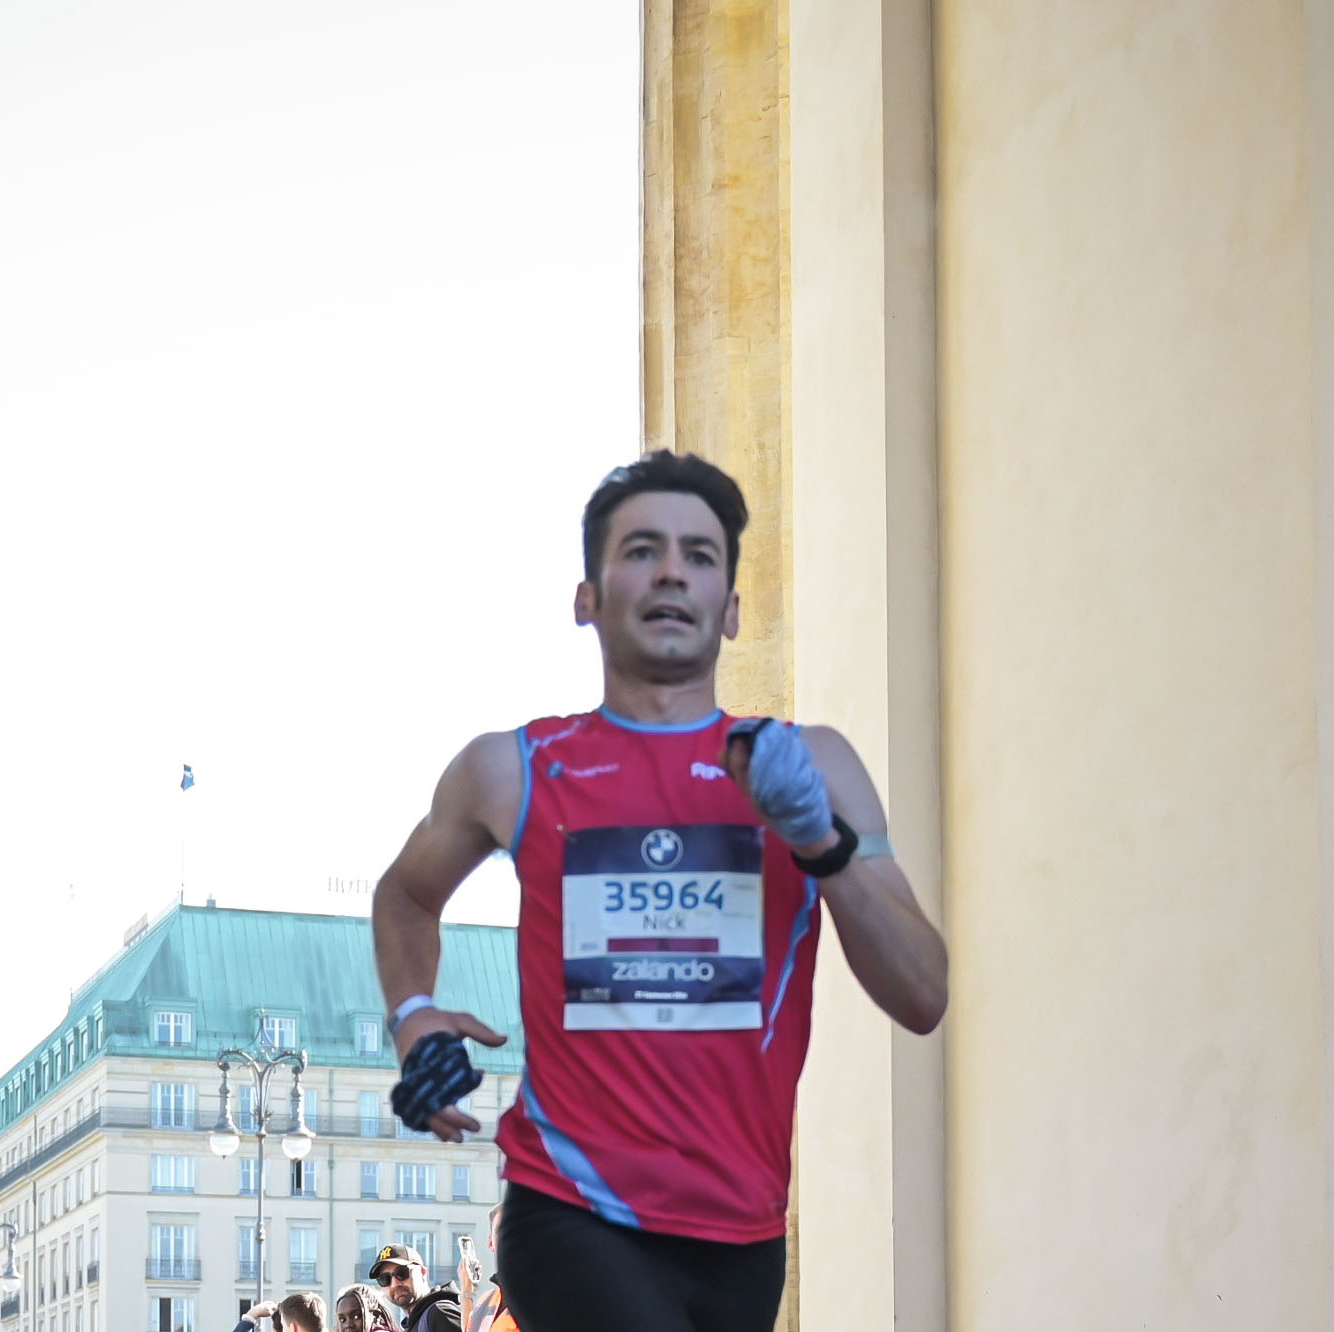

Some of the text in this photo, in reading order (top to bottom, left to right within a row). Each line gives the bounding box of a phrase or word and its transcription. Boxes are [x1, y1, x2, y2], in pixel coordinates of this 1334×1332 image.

[327, 876, 373, 895] HOTE
[604, 880, 724, 911] 35964
[643, 914, 687, 931] Nick
[612, 959, 715, 981] zalando
